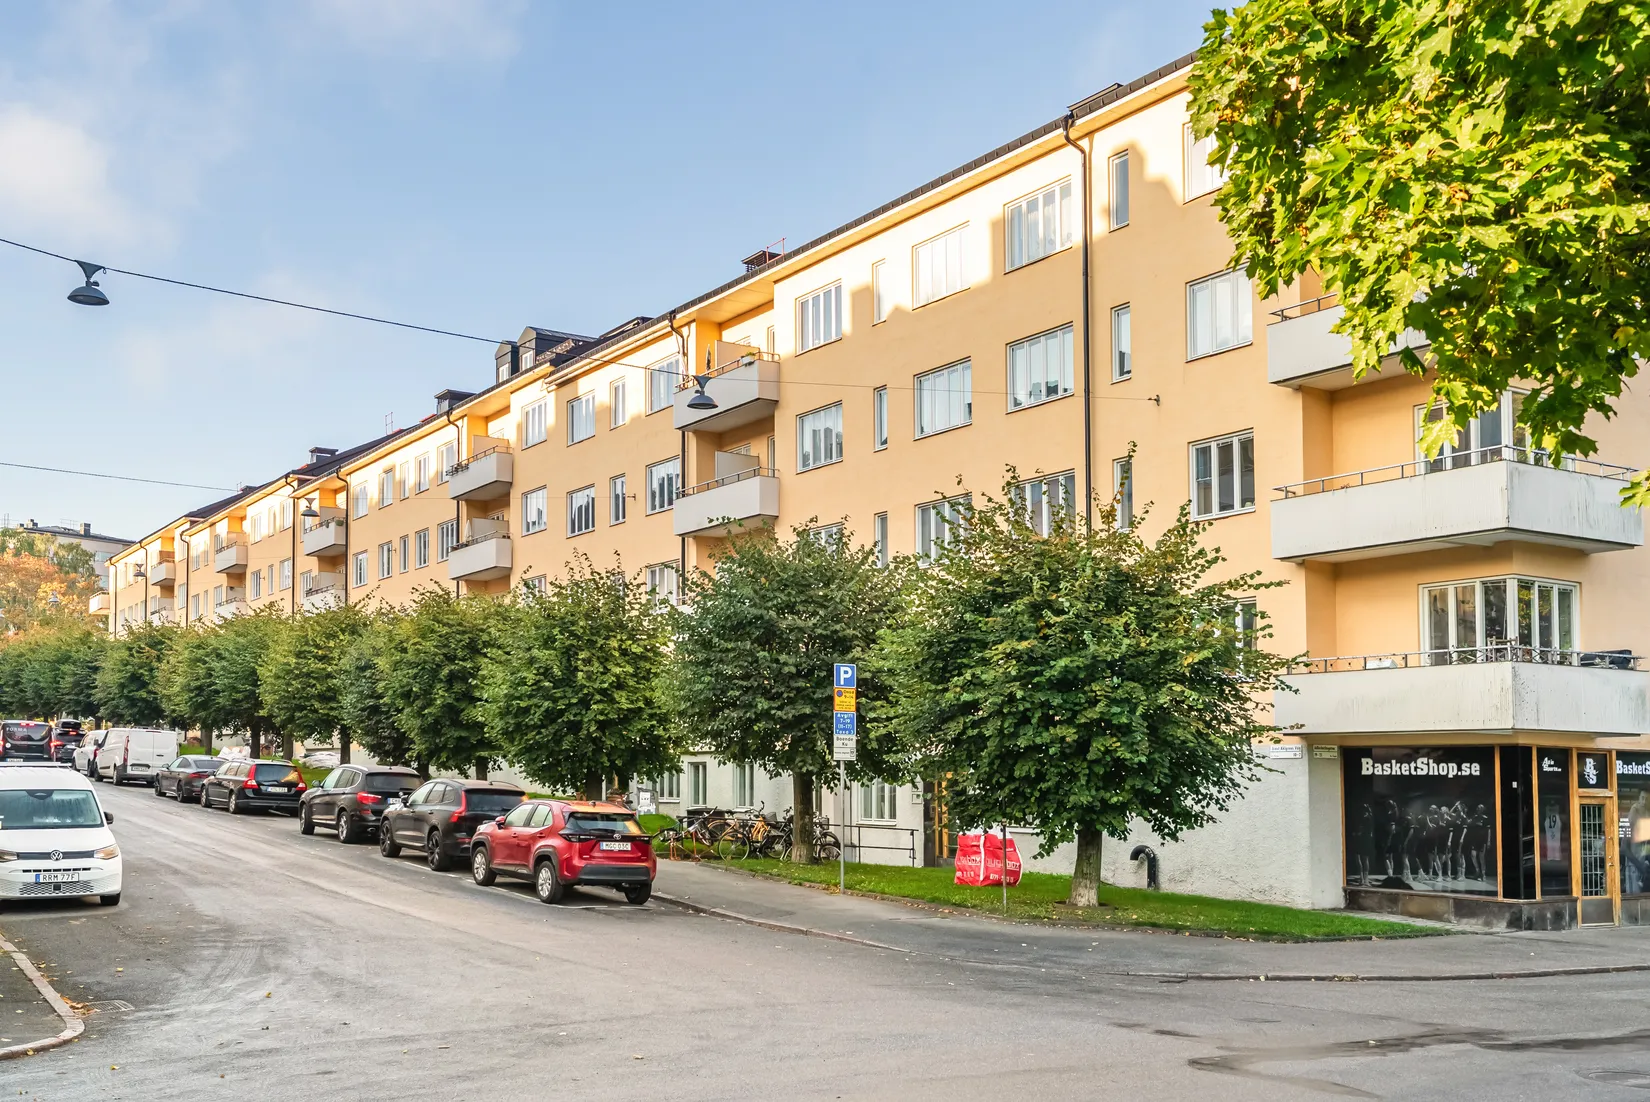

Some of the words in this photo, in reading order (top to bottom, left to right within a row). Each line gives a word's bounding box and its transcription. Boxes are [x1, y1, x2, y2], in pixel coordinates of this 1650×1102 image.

[840, 666, 852, 685] P
[1361, 758, 1480, 778] BasketShop.se
[1549, 814, 1556, 828] 19
